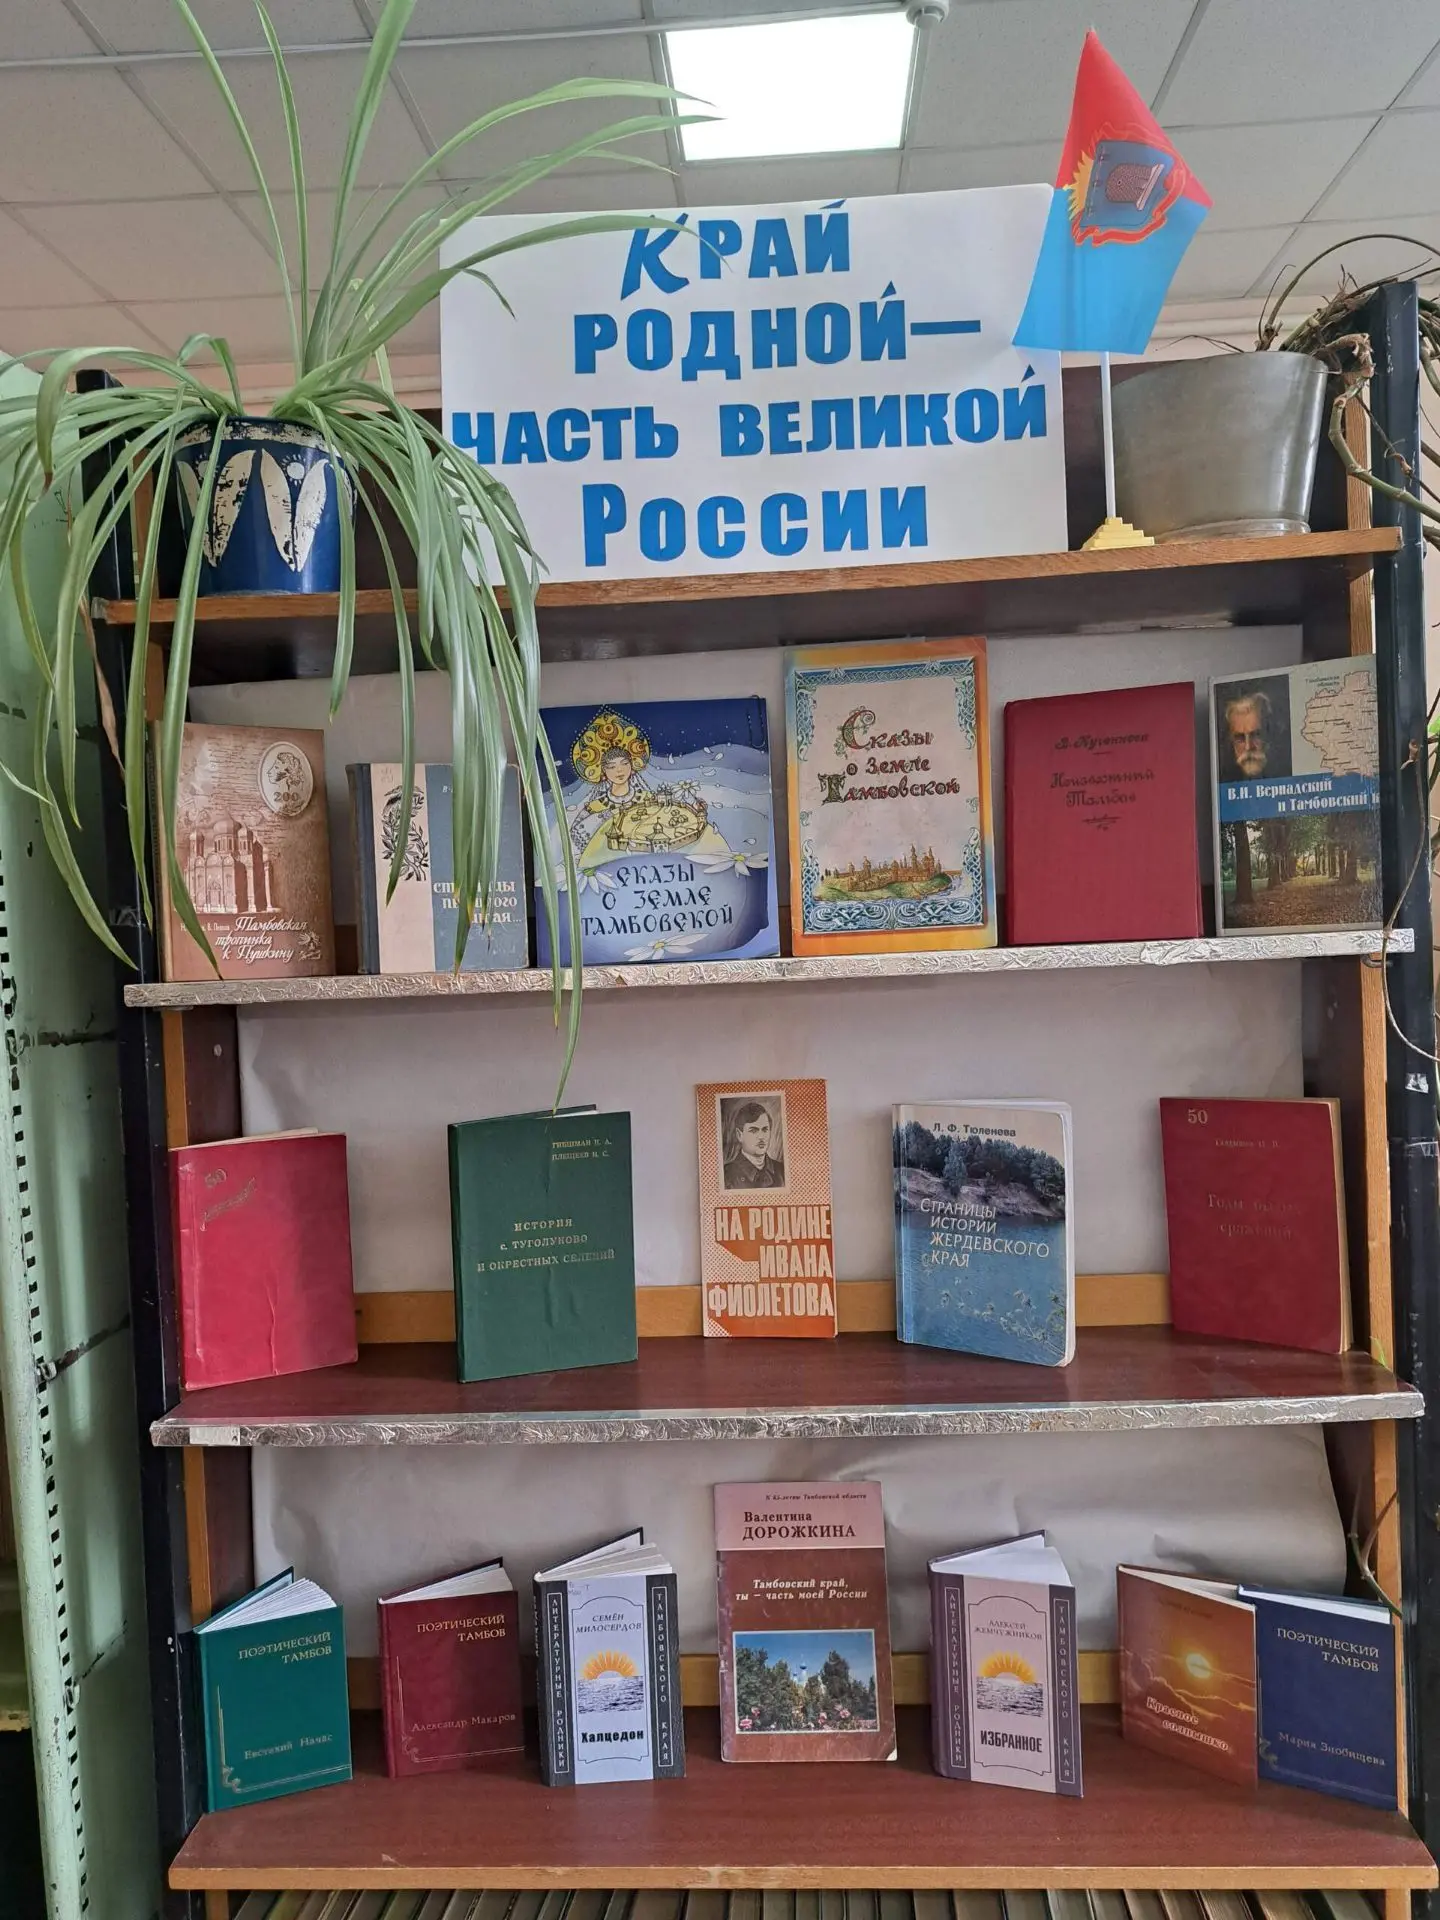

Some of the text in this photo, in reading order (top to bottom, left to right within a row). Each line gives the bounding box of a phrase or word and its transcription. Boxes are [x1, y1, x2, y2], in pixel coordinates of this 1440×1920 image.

[620, 199, 850, 300] КРАЙ
[452, 364, 1047, 466] ЧАСТЬ ВЕЛИКОЙ
[840, 708, 934, 750] Сказы
[846, 763, 858, 776] о
[274, 791, 300, 803] 200
[818, 772, 960, 805] Тамбовской
[1228, 777, 1332, 800] В.И. Вернадский
[1278, 801, 1285, 812] и
[1290, 791, 1367, 811] Тамбовский
[616, 864, 694, 887] СКАЗЫ
[602, 886, 711, 910] О ЗЕМЛЕ
[234, 916, 307, 932] Тамбовская
[581, 903, 733, 936] ТАМБОВСКОЙ
[215, 931, 273, 949] тропинка
[223, 945, 294, 963] к Пушкину
[1187, 1109, 1208, 1124] 50
[932, 1123, 1016, 1137] Л. Ф. Тюленева
[920, 1198, 996, 1221] СТРАНИЦЫ
[514, 1218, 573, 1232] ИСТОРИЯ
[715, 1204, 831, 1243] НА РОДИНЕ
[930, 1216, 997, 1234] ИСТОРИИ
[512, 1234, 588, 1249] ТУГОЛУКОВО
[930, 1232, 1049, 1258] ЖЕРДЕВСКОГО
[477, 1248, 615, 1272] И ОКРЕСТНЫХ СЕЛЕНИЙ
[759, 1244, 832, 1279] ИВАНА
[931, 1250, 970, 1268] КРАЯ
[708, 1282, 834, 1317] ФИОЛЕТОВА
[744, 1511, 812, 1522] Валентина
[742, 1525, 856, 1541] ДОРОЖКИНА
[753, 1577, 848, 1590] Тамбовский край,
[766, 1591, 794, 1600] часть
[798, 1589, 824, 1599] моей
[828, 1588, 868, 1599] России
[416, 1614, 505, 1634] ПОЭТИЧЕСКИЙ
[592, 1613, 624, 1622] СЕМЁН
[989, 1618, 1026, 1630] АЛЕКСЕЙ
[457, 1629, 506, 1643] ТАМБОВ
[575, 1622, 642, 1634] МИЛОСЕРДОВ
[974, 1627, 1043, 1641] ЖЕМЧУЖНИКОВ
[239, 1631, 331, 1660] ПОЭТИЧЕСКИЙ
[1277, 1628, 1379, 1658] ПОЭТИЧЕСКИЙ
[281, 1645, 332, 1664] ТАМБОВ
[1058, 1606, 1068, 1719] ТАМБОВСКОГО
[1321, 1652, 1379, 1672] ТАМБОВ
[551, 1599, 565, 1768] ЛИТЕРАТУРНЫЕ РОДНИКИ
[656, 1593, 669, 1762] ТАМБОВСКОГО КРАЯ
[949, 1594, 962, 1762] ЛИТЕРАТУРНЫЕ РОДНИКИ
[411, 1713, 516, 1734] Александр Макаров
[581, 1729, 644, 1743] Халцедон
[980, 1730, 1043, 1753] ИЗБРАННОЕ
[1278, 1732, 1386, 1766] Мария Знобищева
